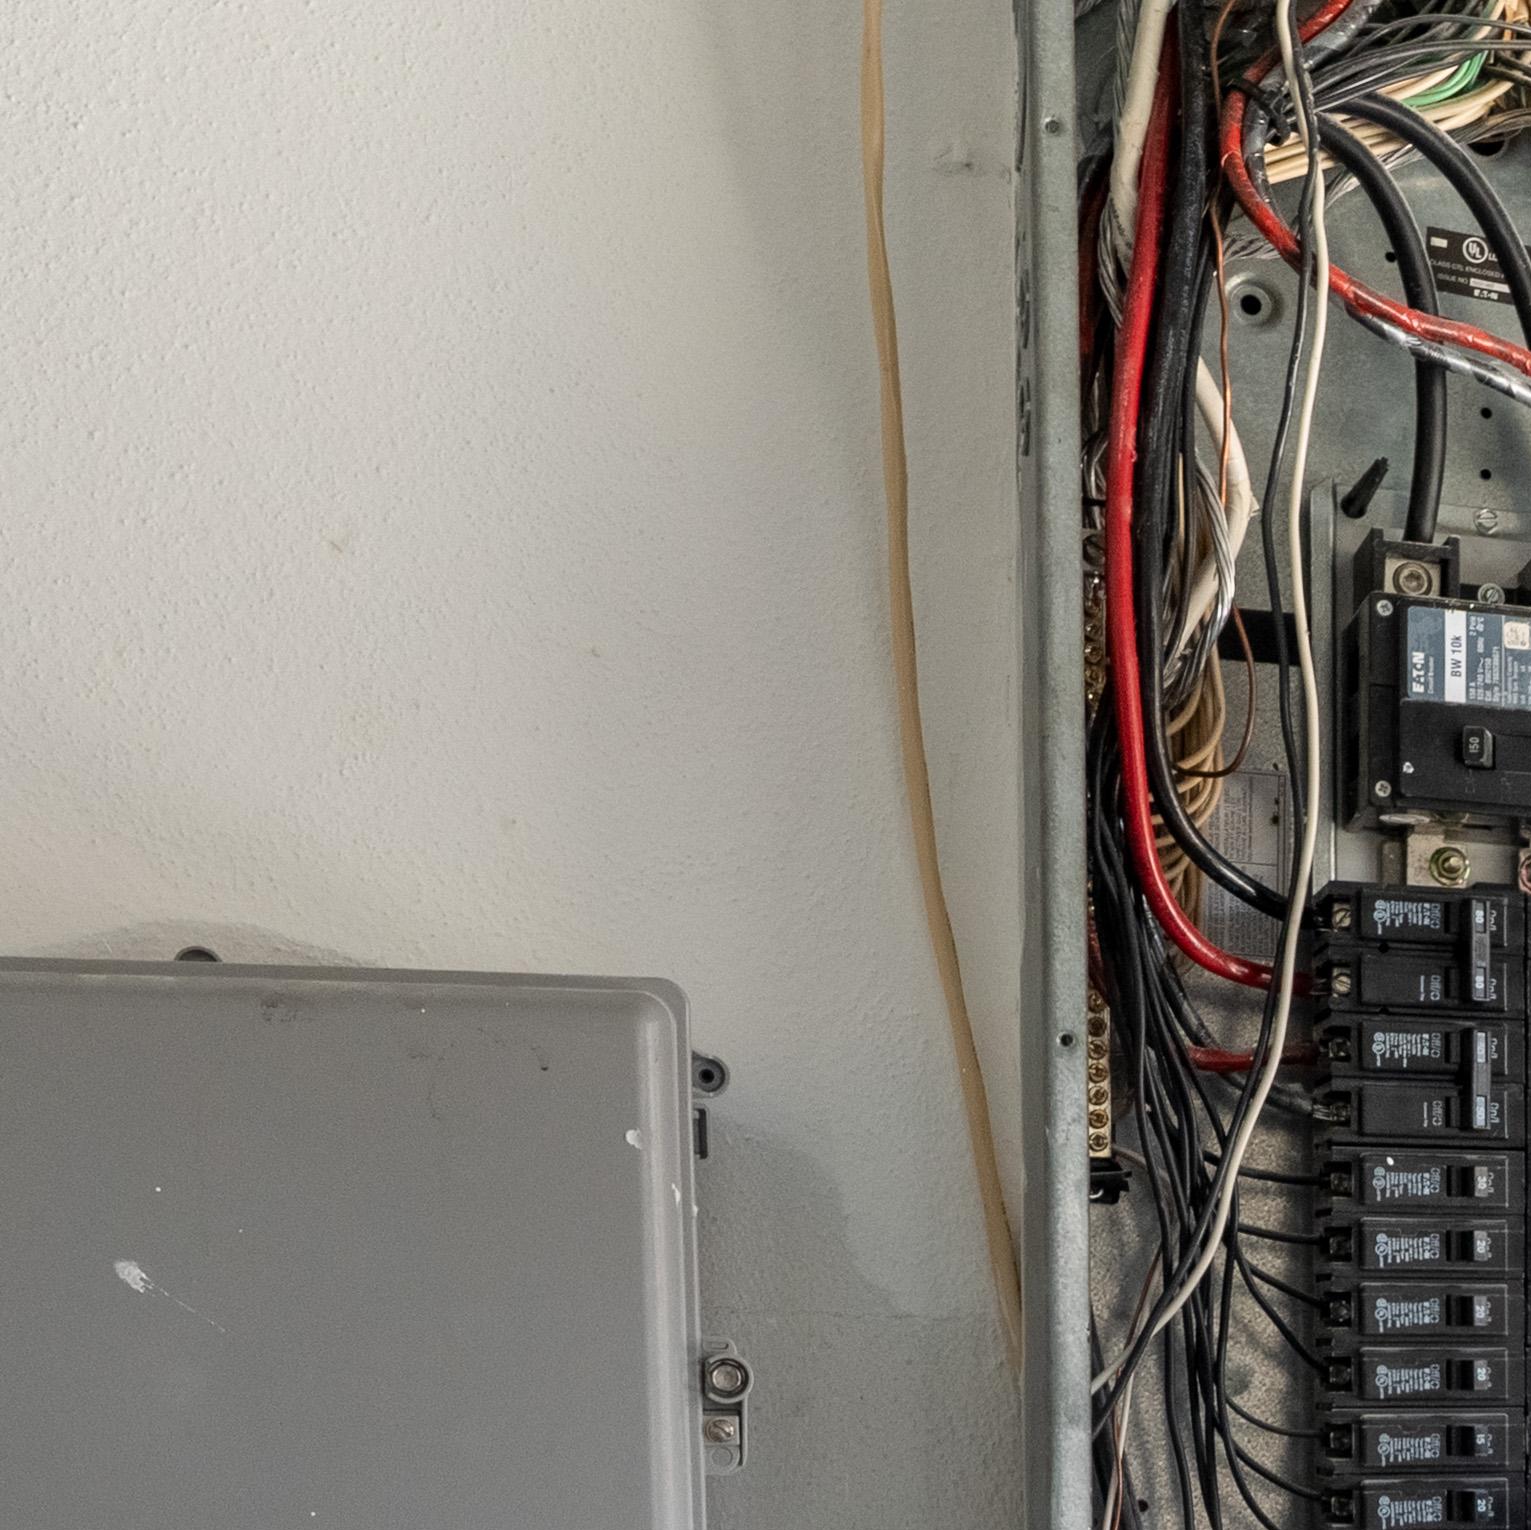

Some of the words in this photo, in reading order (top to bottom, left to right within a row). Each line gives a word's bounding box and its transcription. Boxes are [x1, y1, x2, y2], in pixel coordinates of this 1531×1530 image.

[1451, 635, 1462, 654] 10k
[1451, 658, 1462, 677] BW
[1469, 737, 1479, 753] 150
[1478, 1176, 1486, 1189] 30
[1477, 1240, 1485, 1253] 20
[1476, 1305, 1485, 1318] 20
[1477, 1368, 1486, 1381] 20
[1476, 1434, 1485, 1445] 15
[1477, 1499, 1486, 1512] 20
